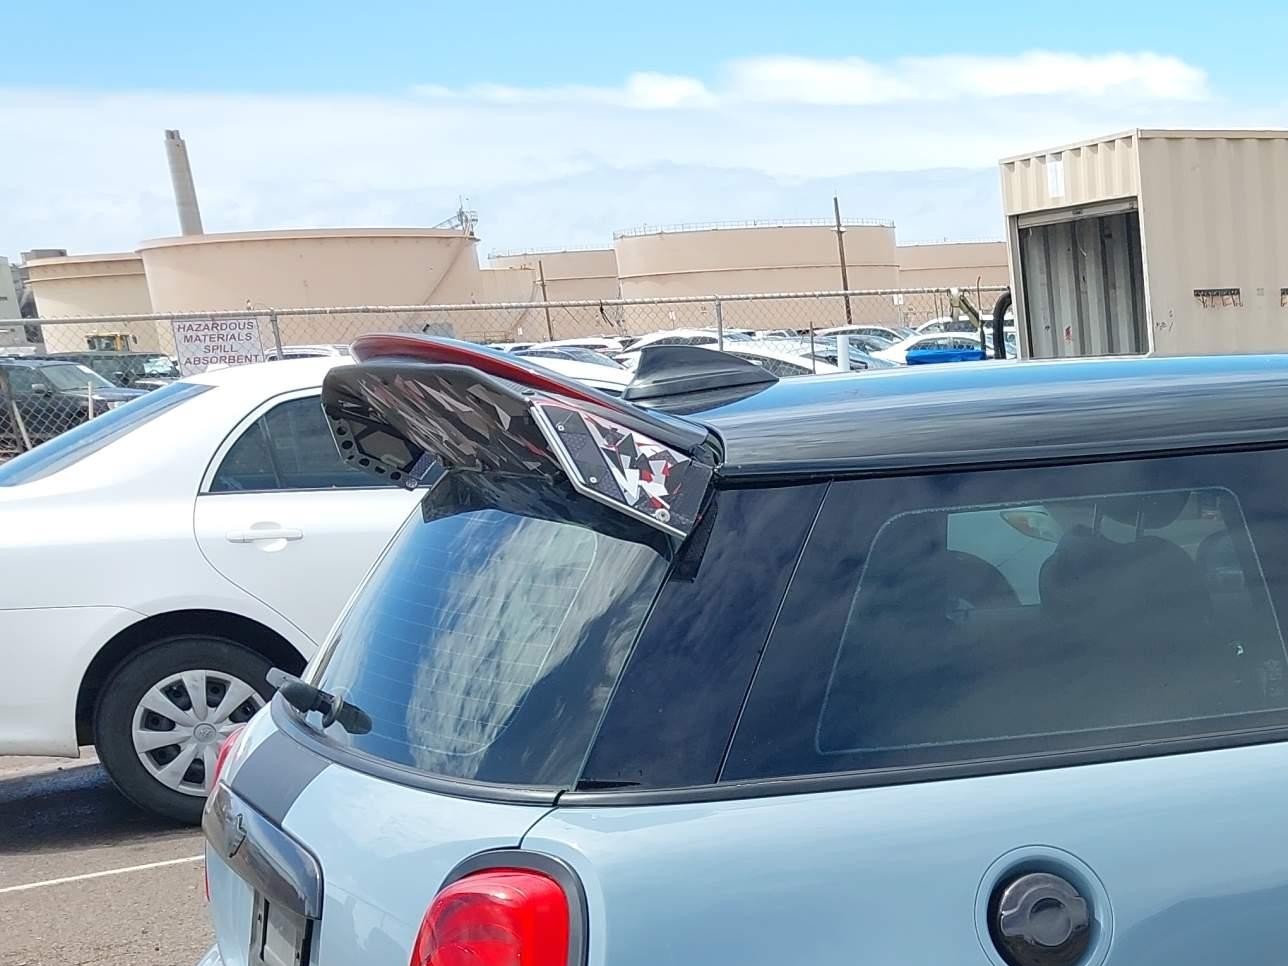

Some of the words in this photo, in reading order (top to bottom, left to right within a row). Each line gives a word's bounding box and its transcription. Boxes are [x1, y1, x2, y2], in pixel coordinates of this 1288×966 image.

[177, 321, 254, 333] HAZARDOUS
[183, 332, 253, 343] MATERIALS
[203, 343, 238, 354] SPILL
[184, 354, 260, 366] ABSORBENT
